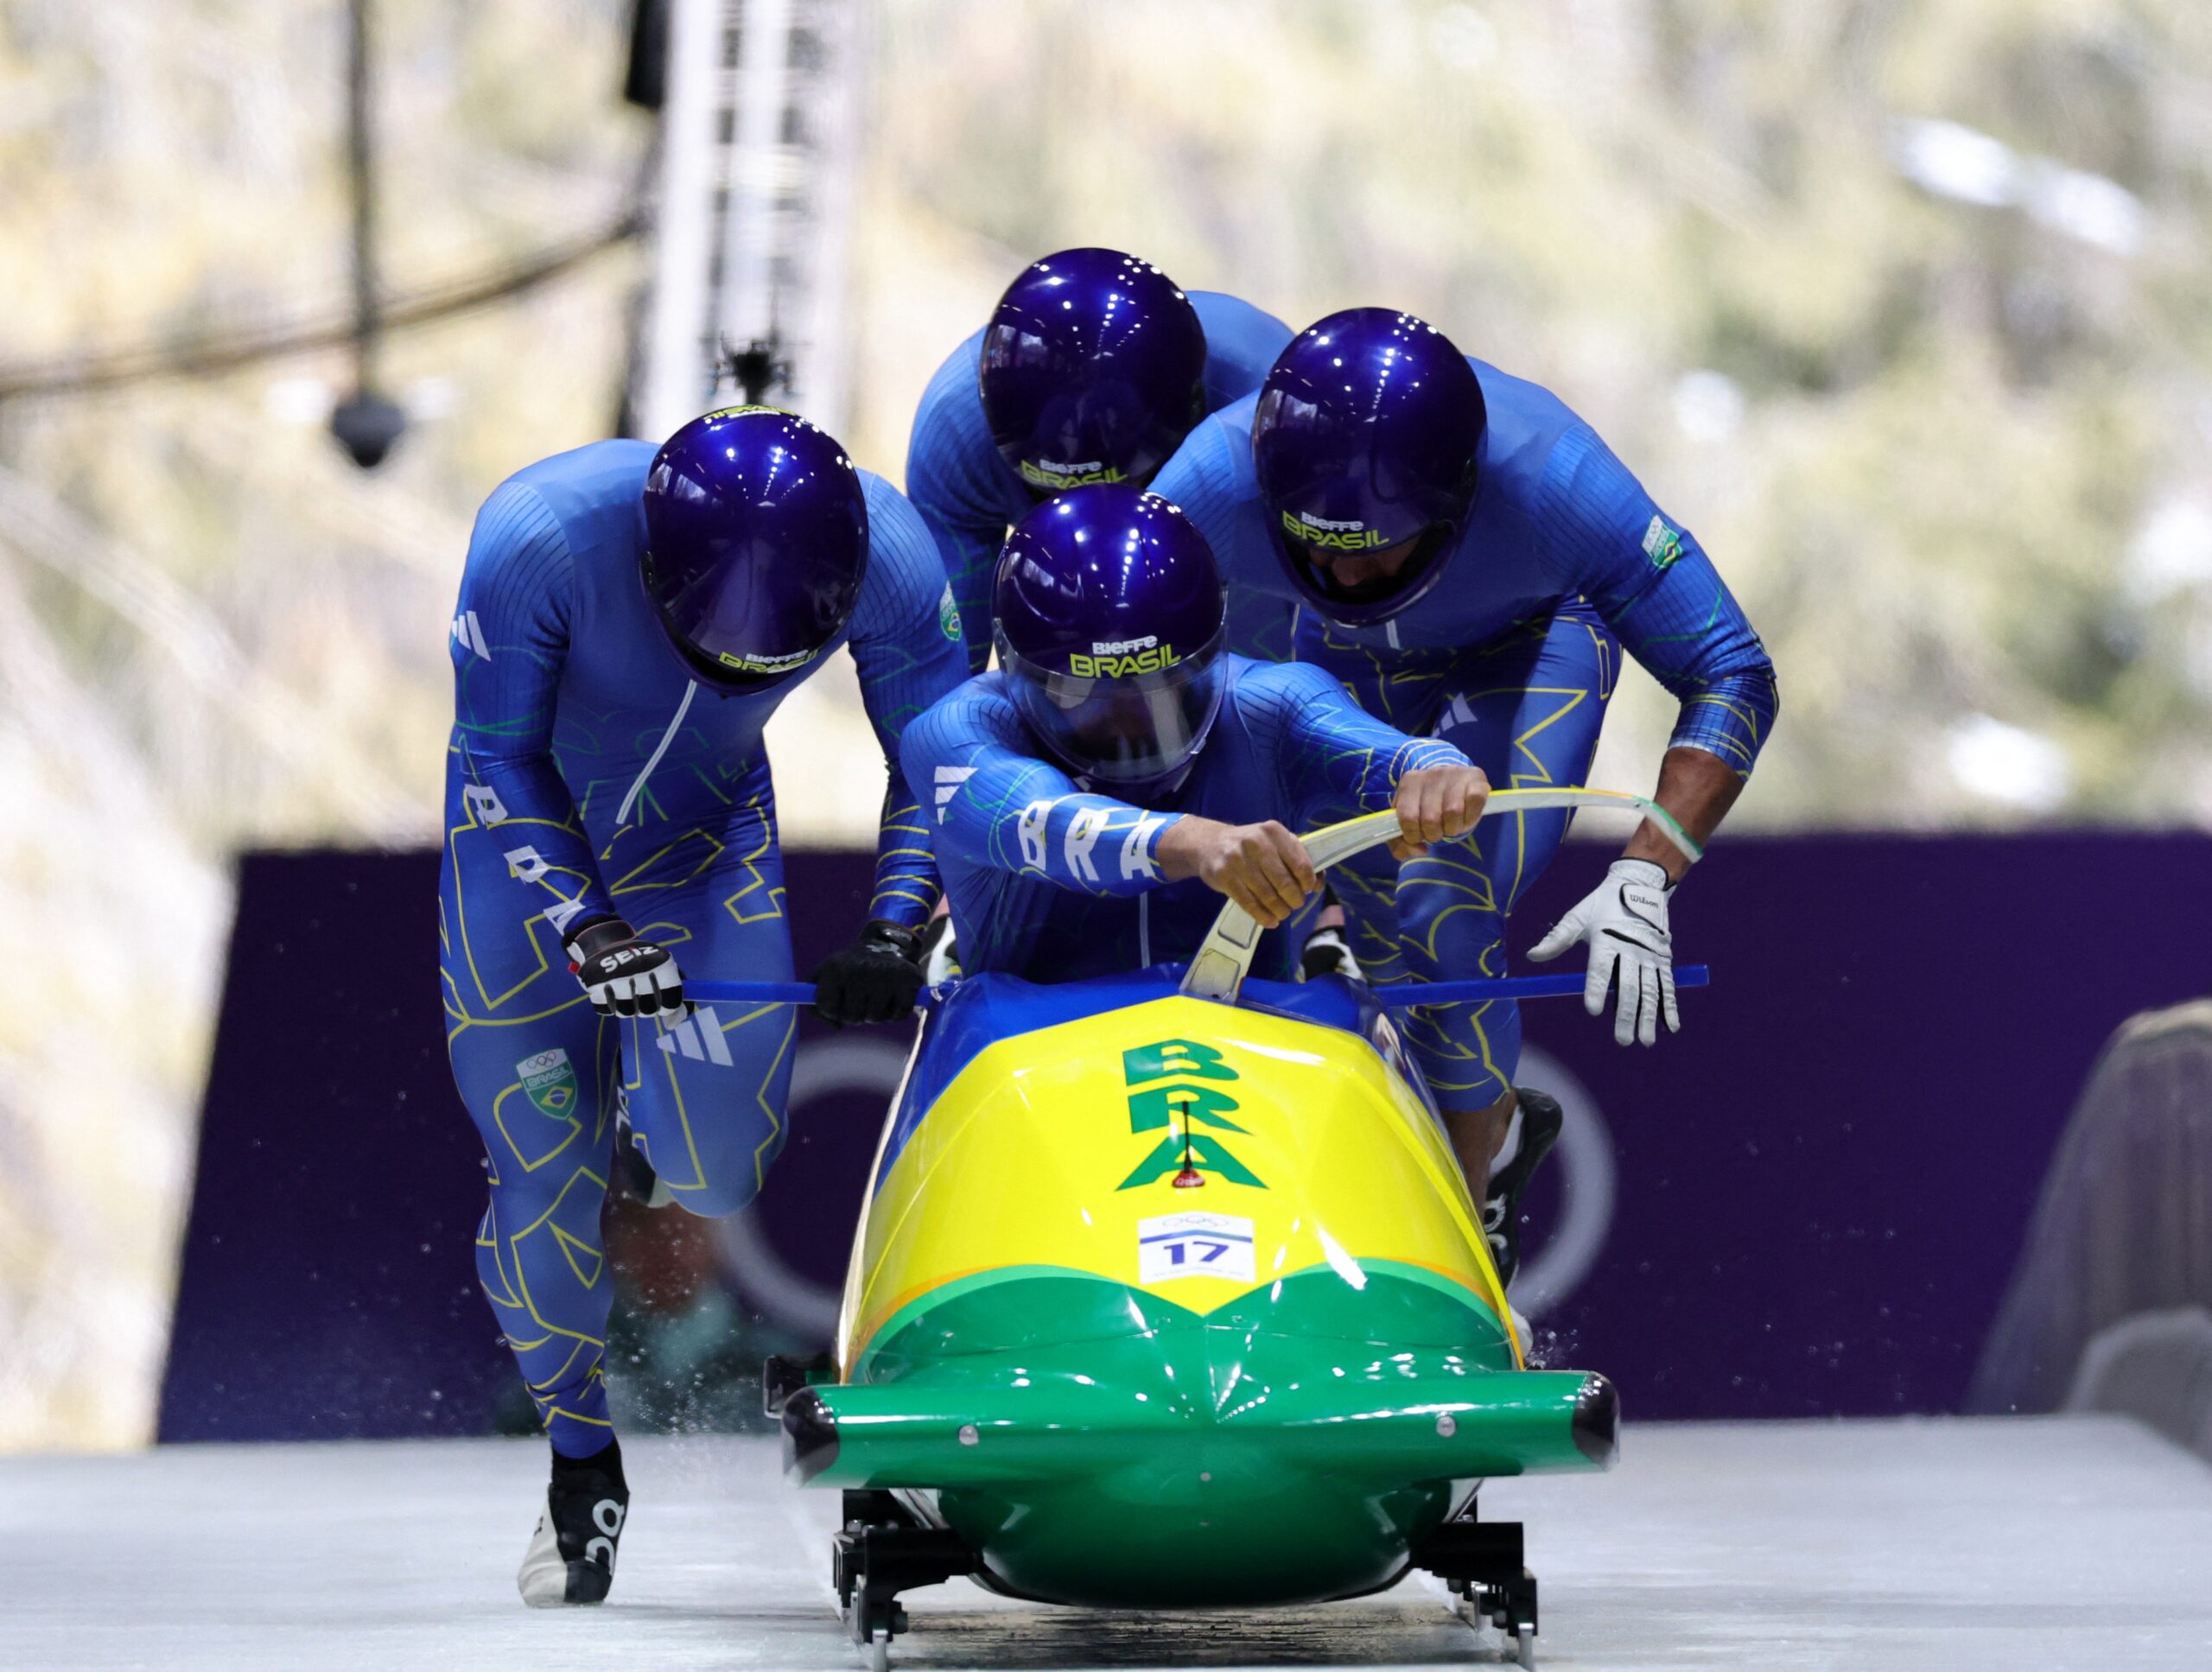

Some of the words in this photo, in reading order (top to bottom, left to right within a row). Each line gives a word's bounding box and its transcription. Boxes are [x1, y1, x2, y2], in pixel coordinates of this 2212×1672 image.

[1282, 511, 1390, 550] BRASIL
[1070, 644, 1181, 678] BRASIL
[1018, 800, 1167, 881] BRA
[1630, 893, 1659, 908] Wilson
[526, 1065, 569, 1087] BRASIL
[1163, 1241, 1230, 1265] 17
